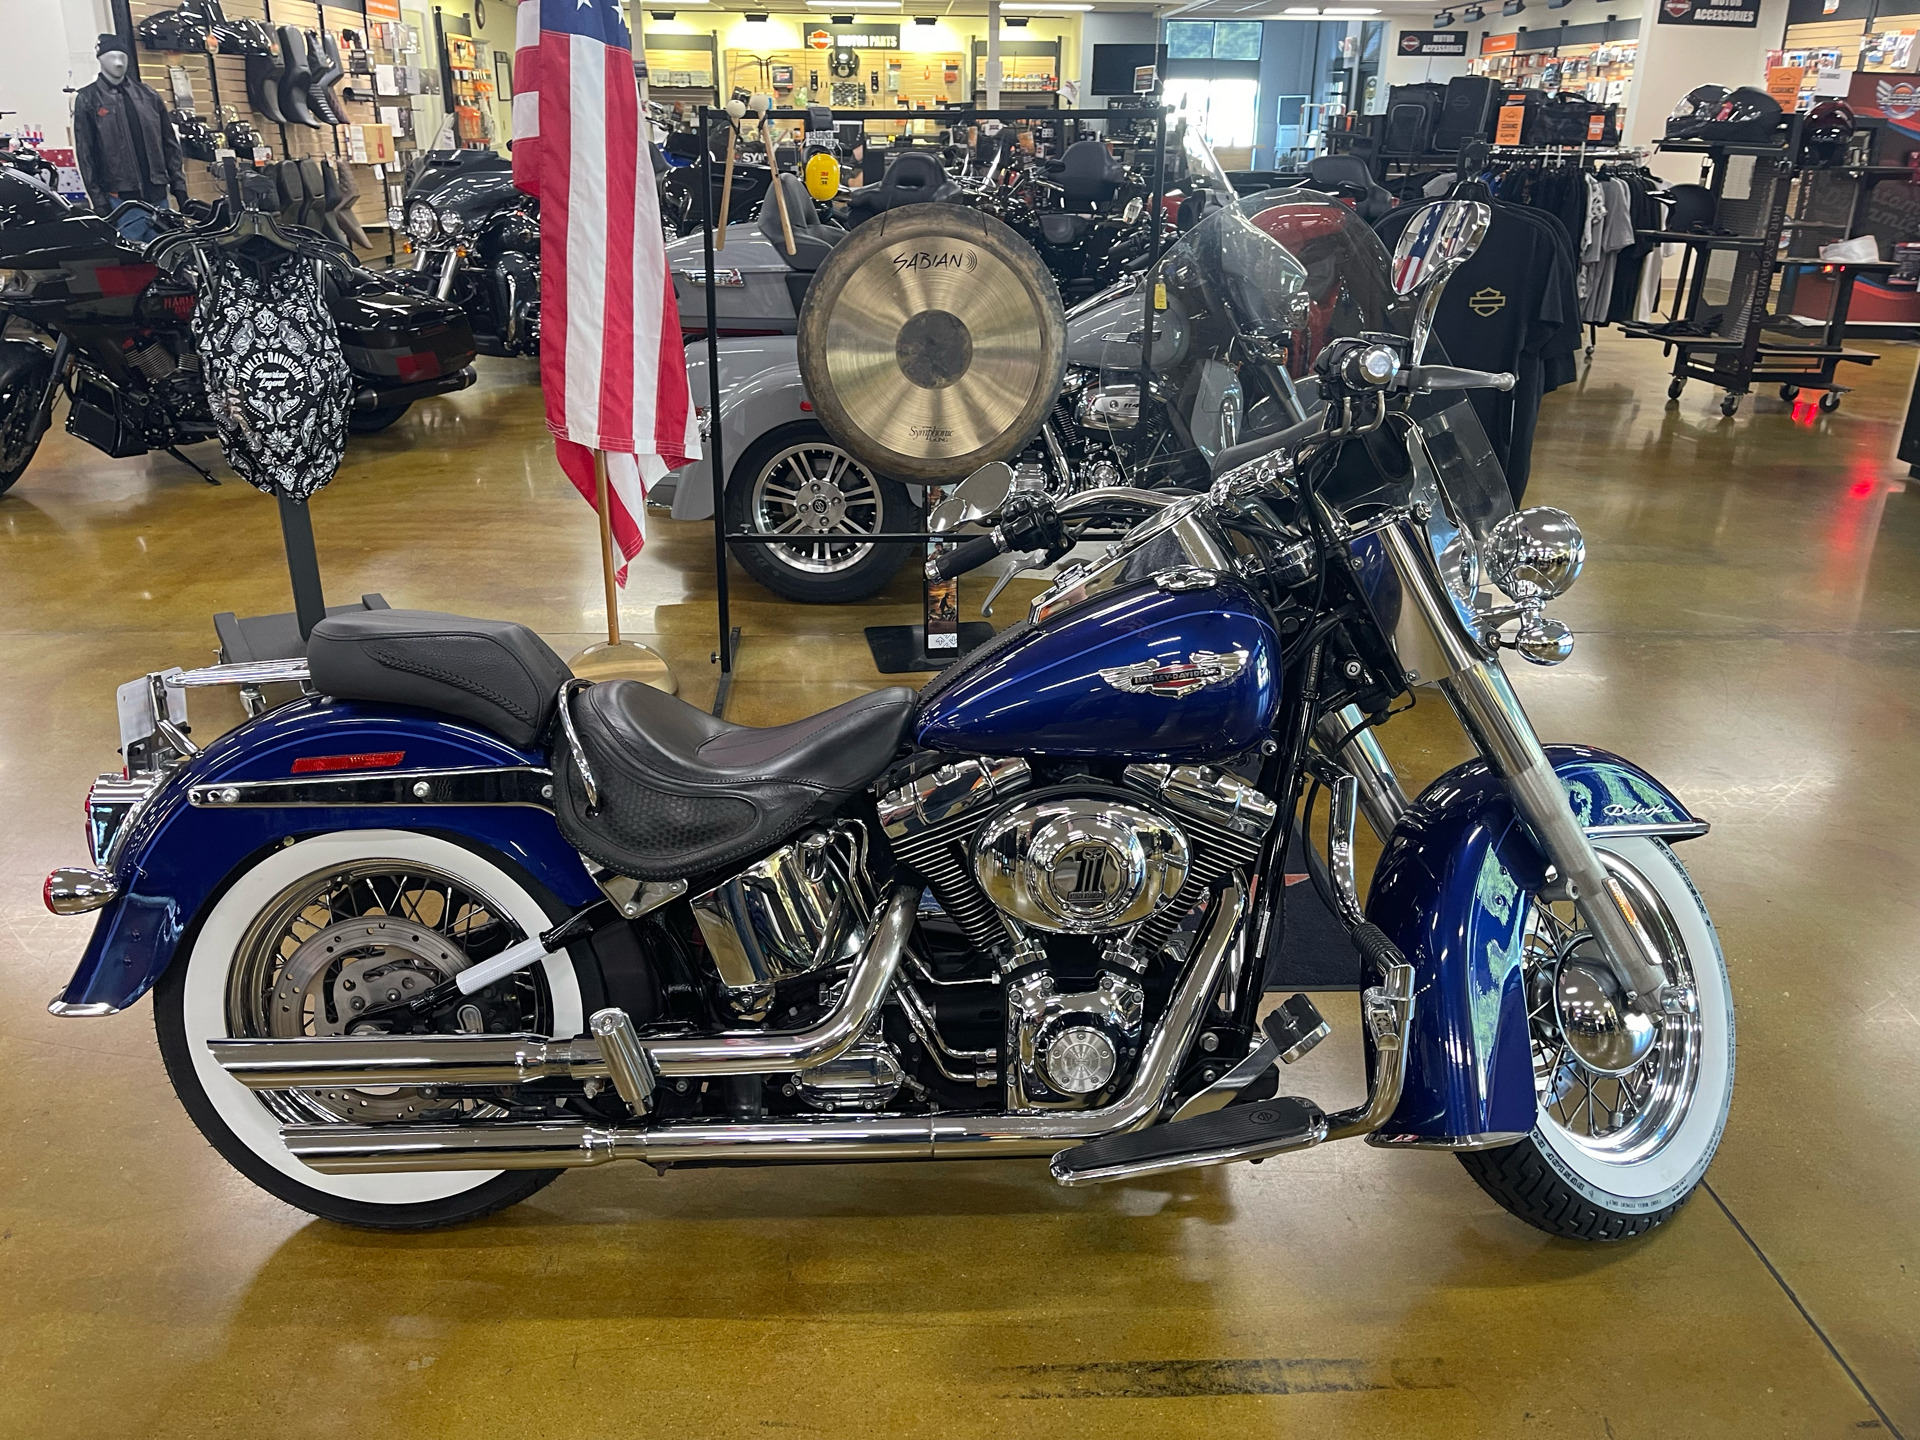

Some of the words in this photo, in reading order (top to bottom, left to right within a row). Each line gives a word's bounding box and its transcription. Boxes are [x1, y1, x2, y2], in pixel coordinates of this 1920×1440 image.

[1693, 8, 1754, 22] ACCESSORIES
[869, 35, 897, 47] PARTS
[892, 252, 964, 277] SABIAN
[1751, 205, 1783, 323] HARLEY-DAVIDSON
[239, 351, 308, 381] HARLEY-DAVIDSON
[255, 369, 290, 380] American
[258, 378, 287, 391] Legend
[908, 425, 955, 441] Symphonic
[1134, 665, 1220, 685] HARLEY-DAVIDSON
[1602, 802, 1674, 818] Deluxe
[1545, 1152, 1586, 1191] DUNLOP
